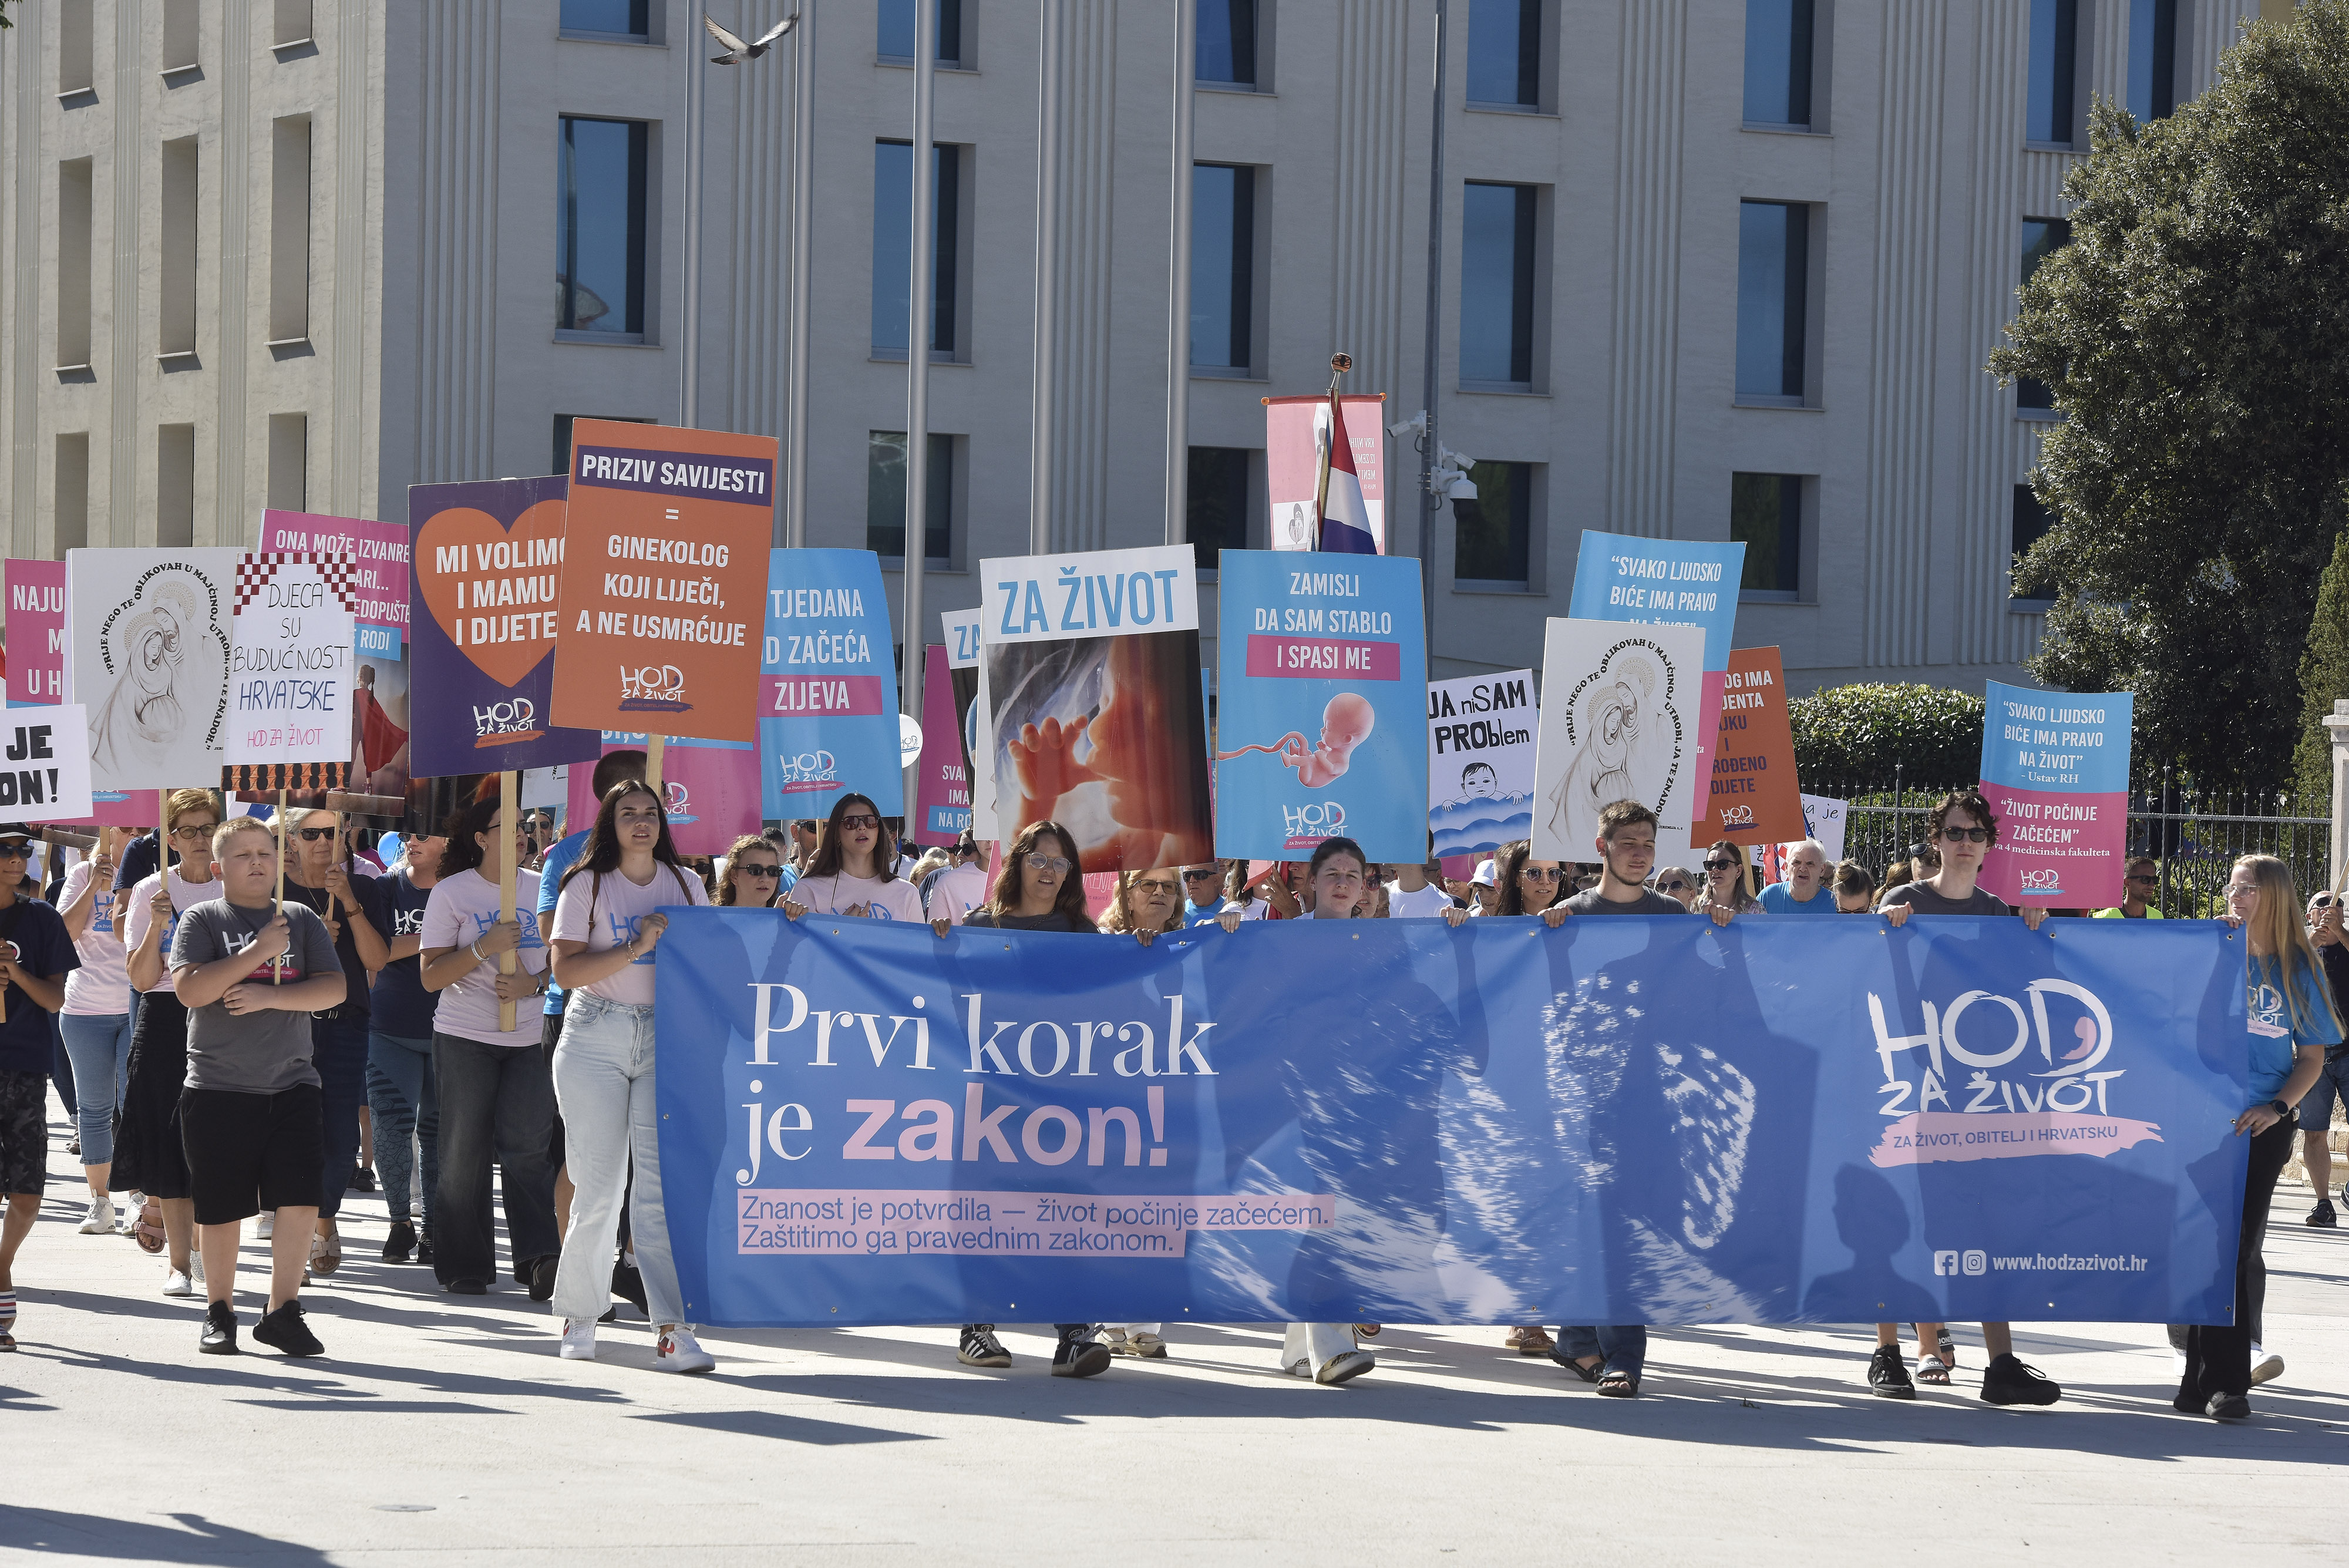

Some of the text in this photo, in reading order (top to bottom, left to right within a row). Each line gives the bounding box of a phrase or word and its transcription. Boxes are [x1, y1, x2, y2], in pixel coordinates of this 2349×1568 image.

[582, 454, 764, 494] PRIZIV SAVIJESTI
[275, 530, 307, 551] ONA
[313, 533, 355, 553] MOŽE
[608, 534, 729, 567] GINEKOLOG
[436, 545, 467, 573] MI
[1670, 561, 1722, 582] LJUDSKO
[268, 583, 323, 608] DJECA
[457, 574, 555, 608] I MAMU
[604, 573, 725, 609] KOJI LIJEČI,
[1290, 572, 1359, 597] ZAMISLI
[14, 584, 63, 613] NAJU
[101, 608, 121, 636] NEGO
[120, 598, 135, 610] TE
[134, 563, 182, 600] OBLIKOVAH
[193, 568, 218, 623] MAJČINOJ
[770, 589, 864, 618] TJEDANA
[998, 566, 1178, 634] ZA ŽIVOT
[1610, 584, 1717, 611] BIĆE IMA PRAVO
[280, 617, 301, 638] SU
[456, 611, 557, 645] I DIJETE
[576, 610, 746, 646] A NE USMRĆUJE
[1256, 608, 1391, 634] DA SAM STABLO
[360, 629, 390, 651] RODI
[788, 629, 871, 664] ZAČEĆA
[233, 644, 348, 672] BUDUĆNOST
[1277, 645, 1371, 670] I SPASI ME
[1600, 638, 1646, 674] OBLIKOVAH
[28, 668, 40, 695] U
[620, 665, 684, 691] HOD
[1587, 671, 1600, 682] TE
[1654, 647, 1676, 700] MAJČINOJ
[1745, 670, 1773, 687] IMA
[240, 680, 335, 711] HRVATSKE
[621, 686, 686, 702] ZA ŽIVOT
[775, 681, 850, 710] ZIJEVA
[1429, 689, 1456, 719] JA
[1567, 679, 1587, 706] NEGO
[1722, 692, 1764, 710] JENTA
[473, 698, 534, 728] HOD
[1664, 702, 1682, 743] UTROBI,
[2050, 708, 2105, 724] LJUDSKO
[247, 723, 323, 748] HOD ZA ŽIVOT
[476, 718, 537, 736] ZA ŽIVOT
[1435, 718, 1530, 754] PROblem
[2004, 724, 2103, 747] BIĆE IMA PRAVO
[6, 725, 53, 761] JE
[1673, 746, 1681, 759] JA
[1724, 738, 1729, 752] I
[780, 750, 835, 775] HOD
[1669, 762, 1678, 775] TE
[2019, 751, 2035, 767] NA
[783, 770, 837, 783] ZA ŽIVOT
[1711, 778, 1755, 795] DIJETE
[2028, 771, 2079, 783] Ustav RH
[948, 789, 969, 805] IMA
[938, 812, 953, 827] NA
[1283, 801, 1345, 829] HOD
[1720, 805, 1752, 821] HOD
[1822, 803, 1839, 819] je
[2044, 803, 2098, 821] POČINJE
[1285, 824, 1348, 837] ZA ŽIVOT
[2013, 846, 2066, 856] medicinska
[2068, 847, 2110, 856] fakulteta
[2020, 869, 2059, 883] HOD
[395, 923, 411, 936] ZA
[746, 982, 1220, 1077] Prvi korak
[1867, 978, 2113, 1083] HOD
[1876, 1066, 2127, 1117] ZA ŽIVOT
[736, 1079, 1168, 1186] je zakon!
[1893, 1125, 2118, 1149] ZA ŽIVOT, OBITELJ I HRVATSKU
[742, 1196, 1328, 1231] Znanost je potvrdila život počinje začećem.
[742, 1224, 1173, 1254] Zaštitimo ga pravednim zakonom.
[1993, 1253, 2148, 1271] www.hodzazivot.hr
